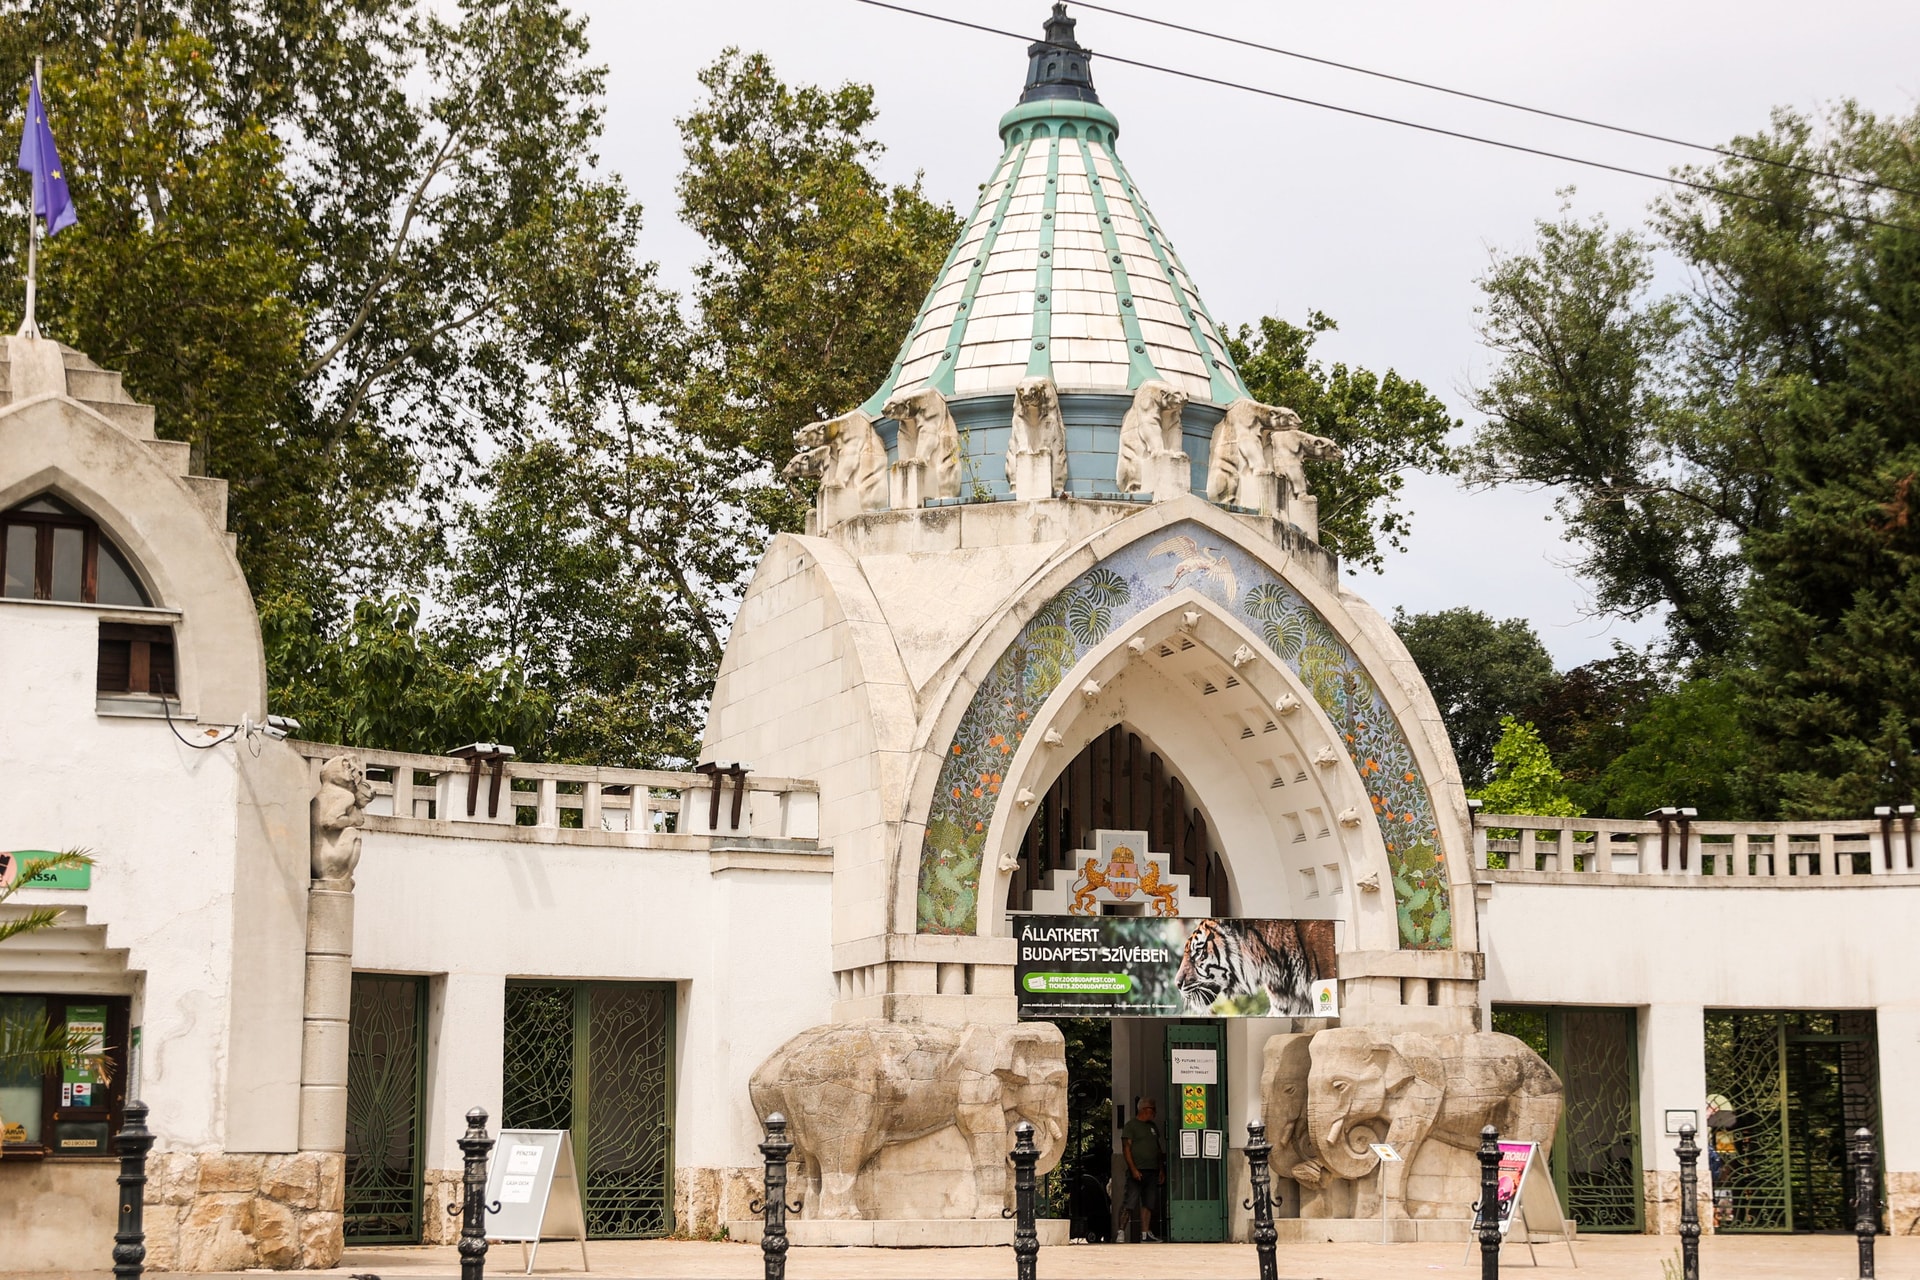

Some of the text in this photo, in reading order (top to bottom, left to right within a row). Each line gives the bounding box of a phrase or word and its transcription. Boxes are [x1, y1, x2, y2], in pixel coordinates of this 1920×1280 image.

[1022, 925, 1100, 942] ÁLLATKERT
[1022, 946, 1169, 963] BUDAPEST SZÍVÉBEN
